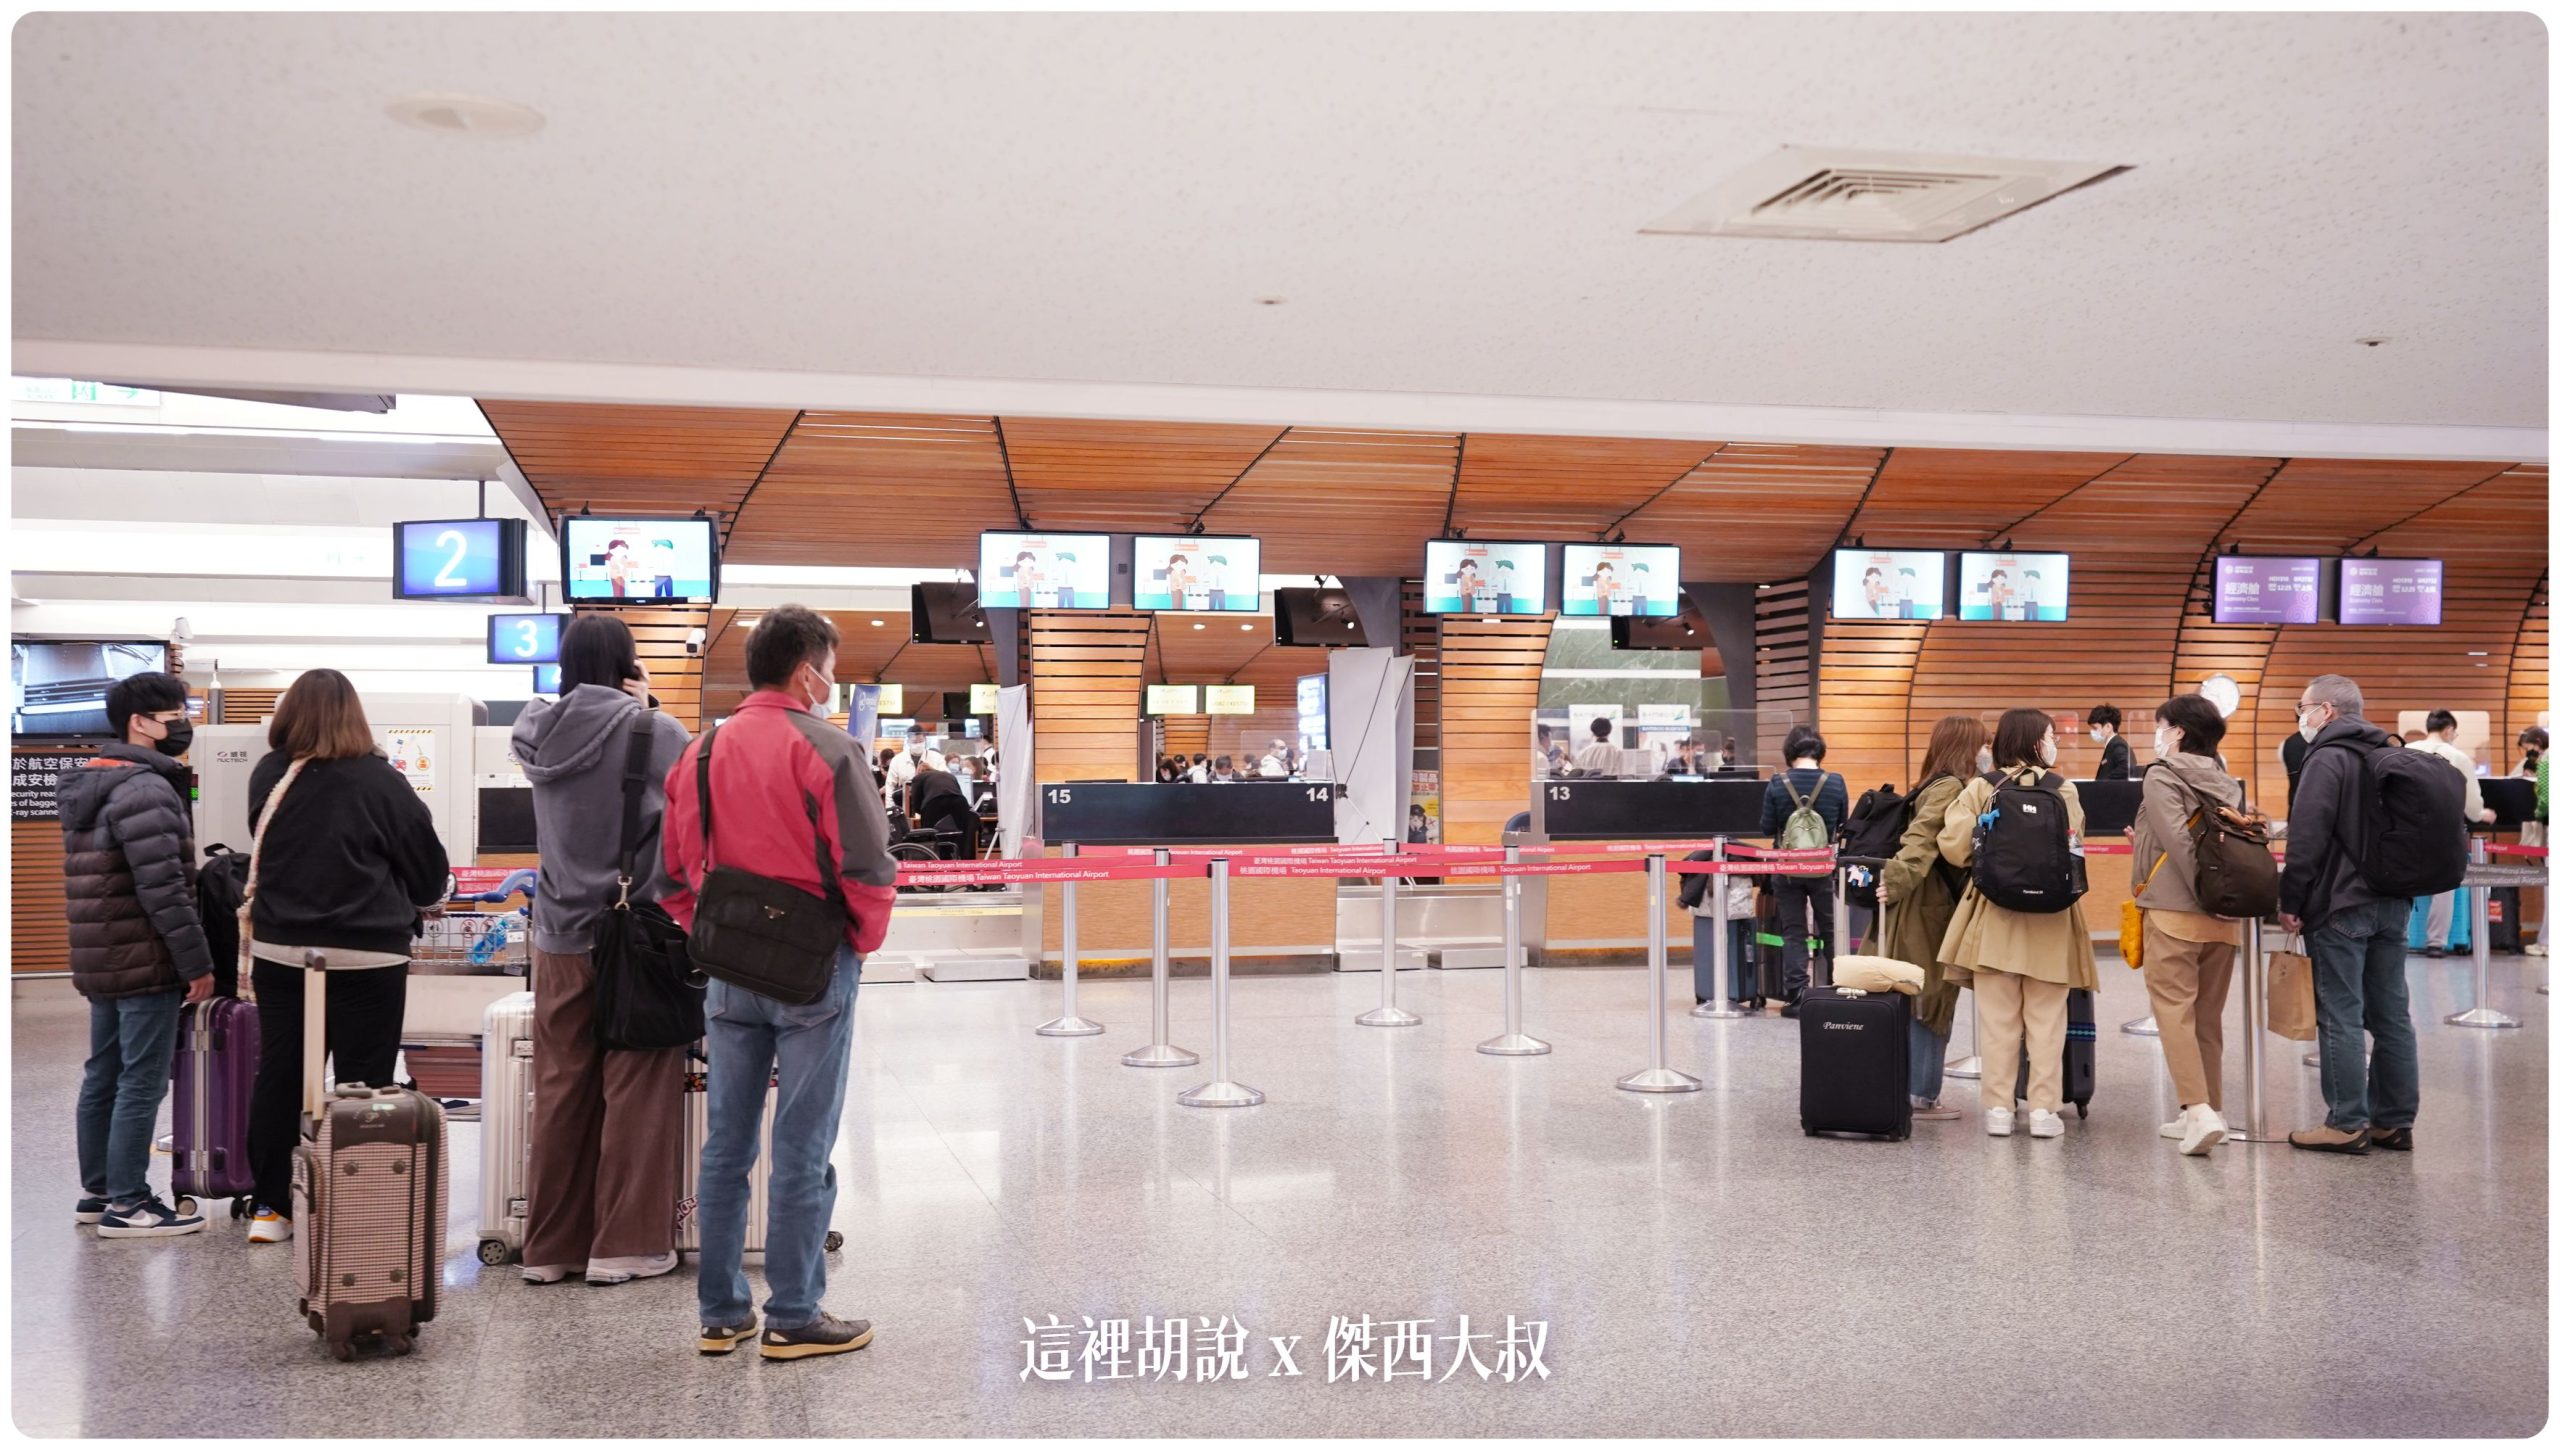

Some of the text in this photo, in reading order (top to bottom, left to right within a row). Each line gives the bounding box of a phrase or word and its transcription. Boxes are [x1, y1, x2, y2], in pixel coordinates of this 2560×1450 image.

[434, 530, 468, 587] 2
[514, 619, 539, 658] 3
[1048, 789, 1071, 804] 15
[1306, 787, 1328, 801] 14
[1549, 786, 1570, 800] 13
[903, 861, 926, 869] Taiwan
[927, 861, 954, 870] Taoyuan
[955, 860, 997, 868] International
[998, 860, 1023, 868] Airport
[1330, 857, 1355, 865] Taoyuan
[1356, 856, 1394, 864] International
[1291, 866, 1319, 875] Taoyuan
[1362, 866, 1387, 875] Airport
[1499, 865, 1526, 874] Taoyuan
[1568, 863, 1592, 871] Airport
[1799, 863, 1825, 871] Taoyuan
[976, 873, 1001, 881] Taiwan
[1002, 872, 1034, 882] Taoyuan
[1035, 870, 1081, 879] International
[1082, 870, 1110, 880] Airport
[2474, 877, 2521, 885] International
[2521, 876, 2548, 885] Airport
